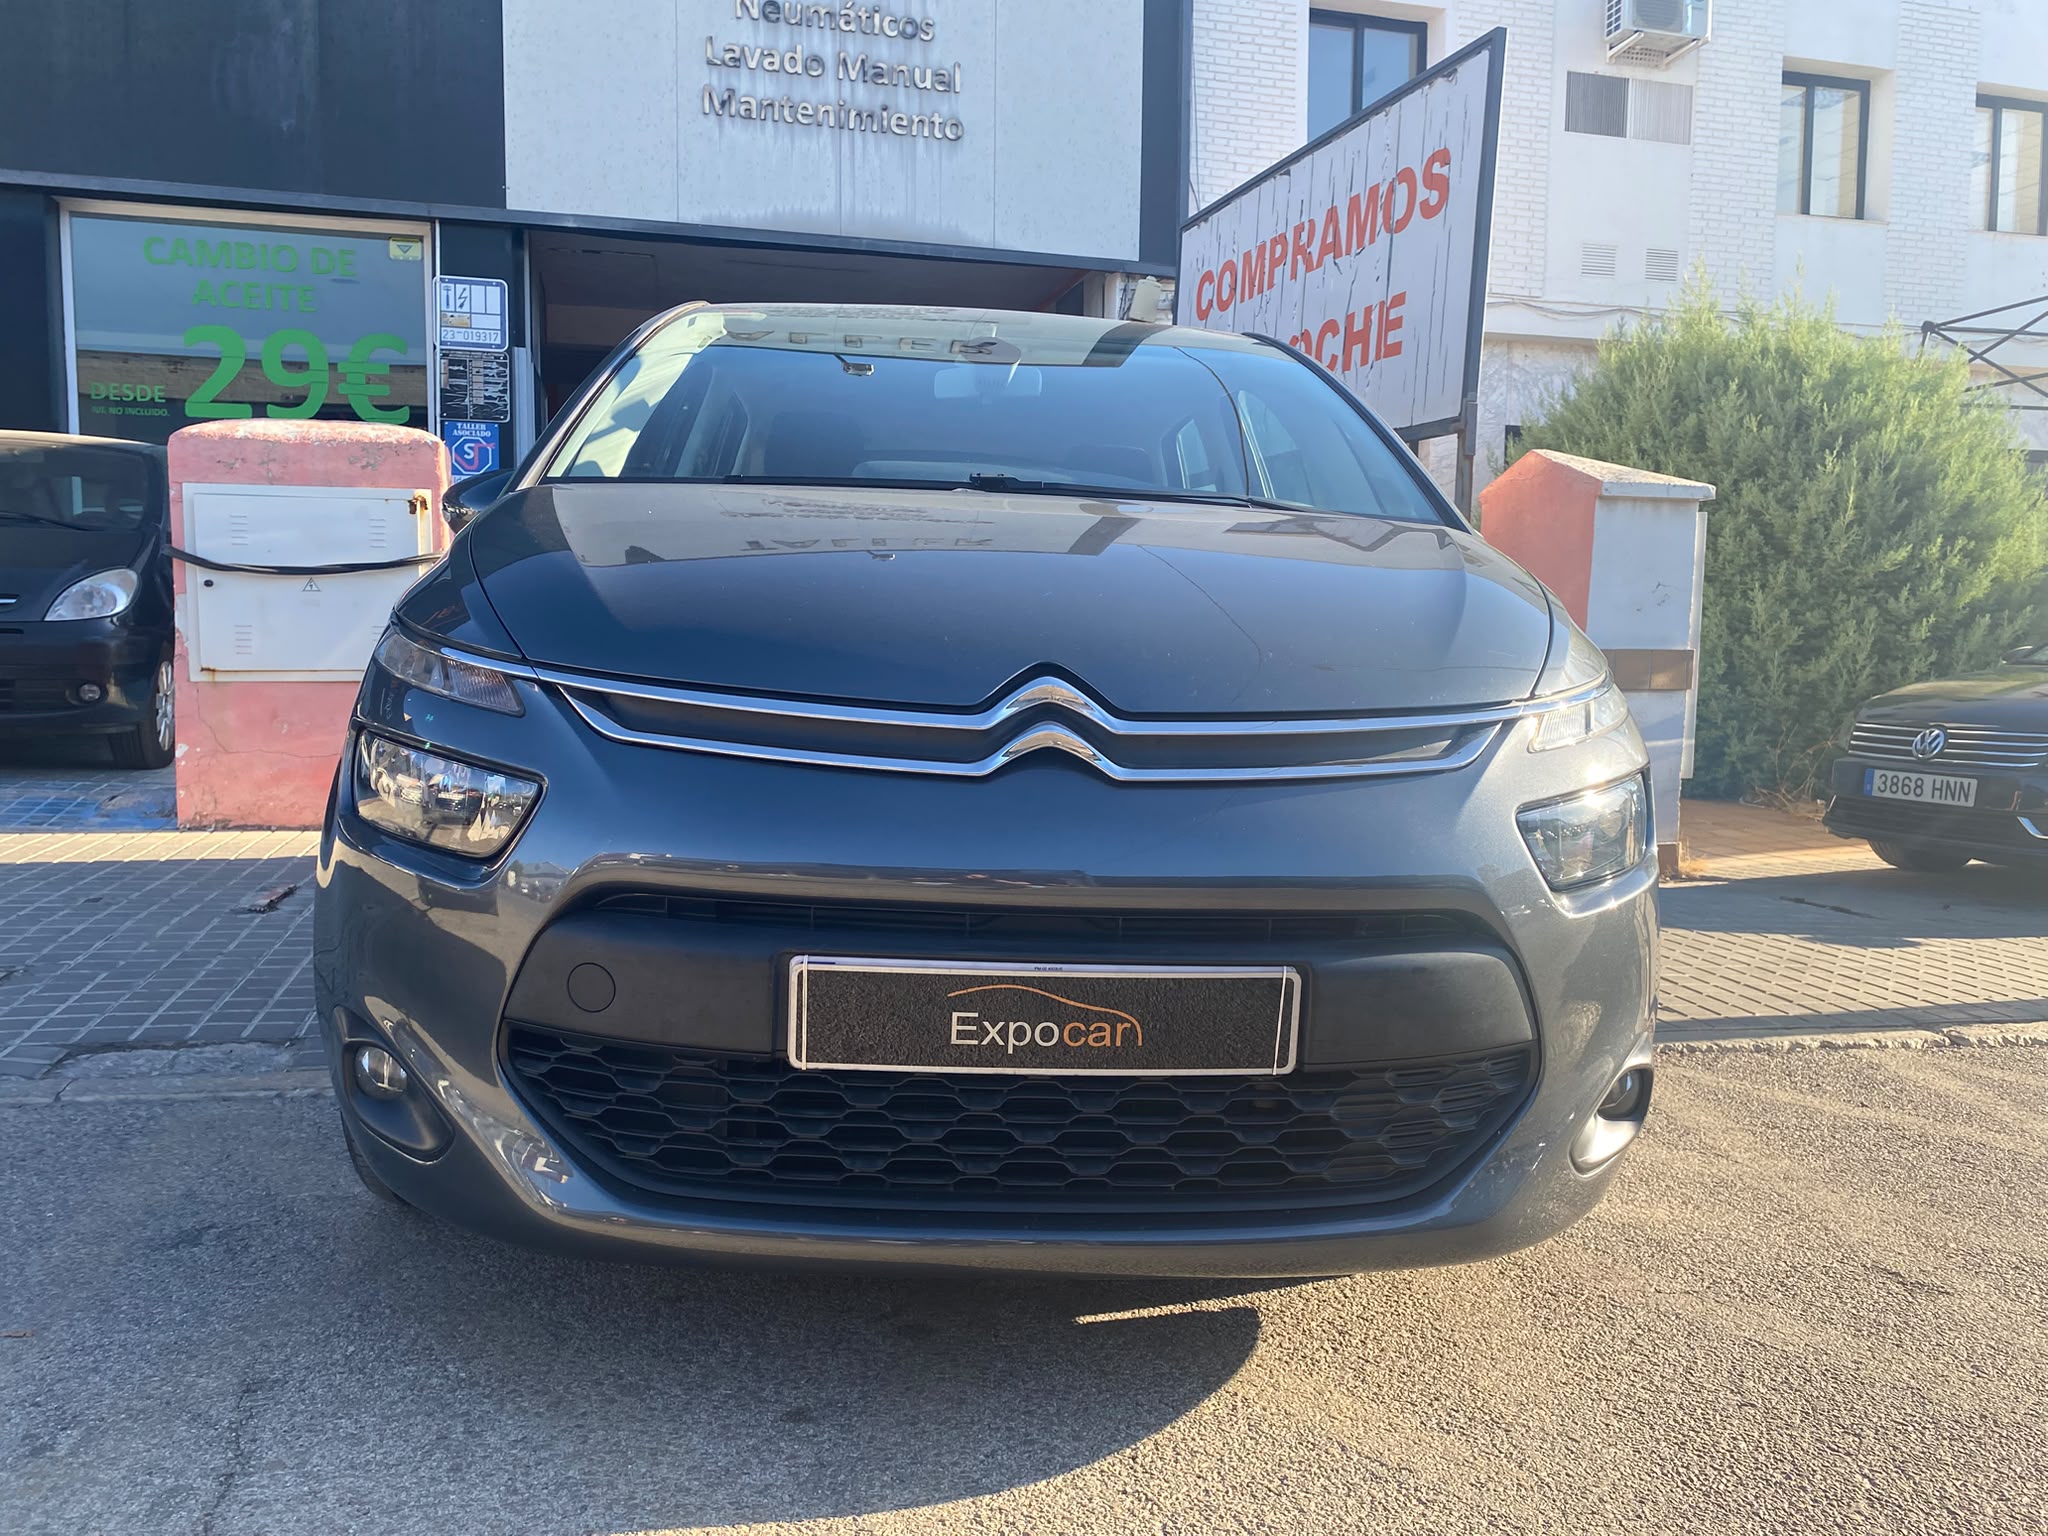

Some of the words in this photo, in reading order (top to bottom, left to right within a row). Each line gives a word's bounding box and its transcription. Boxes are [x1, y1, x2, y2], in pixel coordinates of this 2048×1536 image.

[734, 0, 936, 42] Neumáticos
[705, 36, 826, 78] Lavado
[837, 51, 962, 94] Manual
[702, 84, 965, 141] Mantenimiento
[1195, 147, 1451, 322] COMPRAMOS
[143, 236, 298, 273] CAMBIO
[311, 247, 358, 277] DE
[191, 279, 318, 313] ACEITE
[90, 382, 167, 403] DESDE
[183, 324, 411, 425] 29€
[452, 429, 492, 438] ASOCIADO
[1877, 773, 1924, 798] 3868
[1931, 778, 1972, 803] HNN
[950, 1011, 1132, 1055] Expocar
